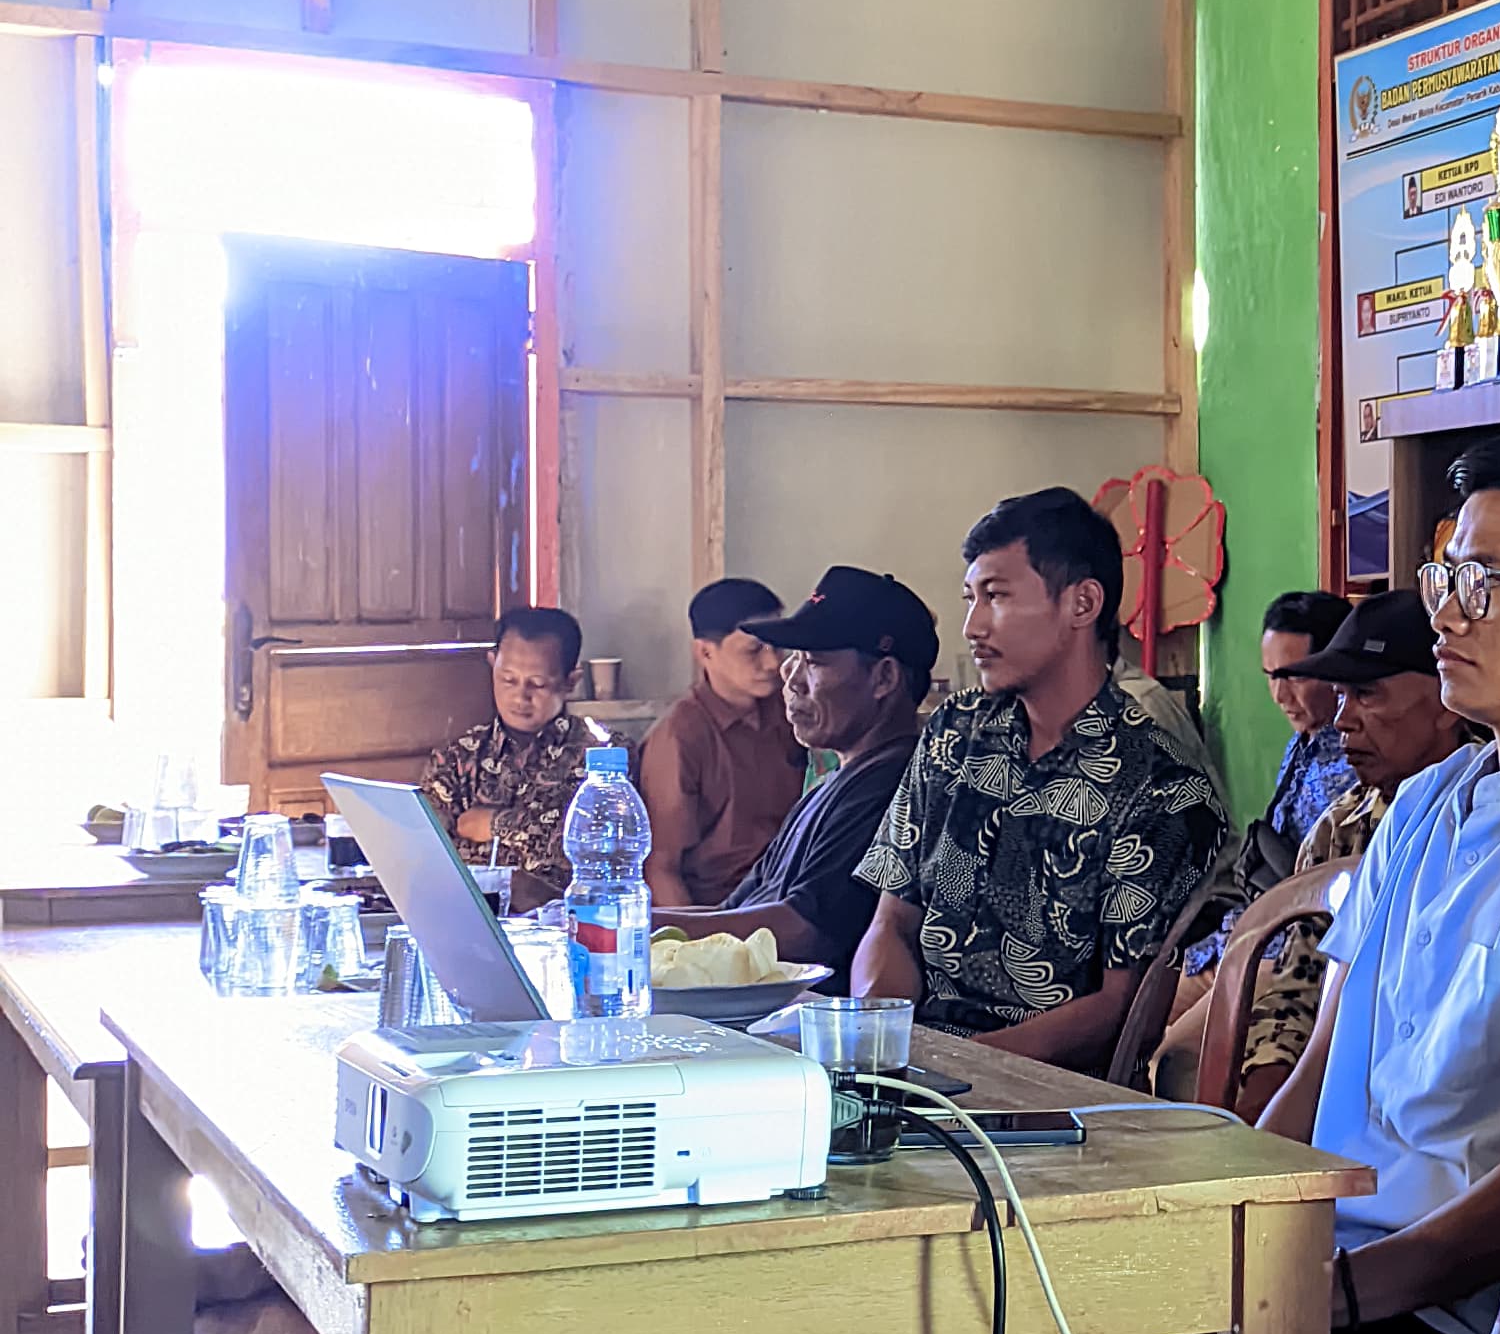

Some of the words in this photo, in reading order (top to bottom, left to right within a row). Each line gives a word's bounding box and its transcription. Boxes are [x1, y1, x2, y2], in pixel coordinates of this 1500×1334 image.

[1408, 39, 1461, 72] STRUKTUR
[1381, 82, 1410, 111] BADAN
[1438, 166, 1462, 181] KETUA
[1464, 160, 1479, 174] BPD
[1434, 192, 1446, 204] EDI
[1447, 181, 1484, 200] WANTORO
[1386, 290, 1408, 304] WAKIL
[1409, 284, 1432, 299] KETUA
[1389, 307, 1430, 325] SUPRIYANTO
